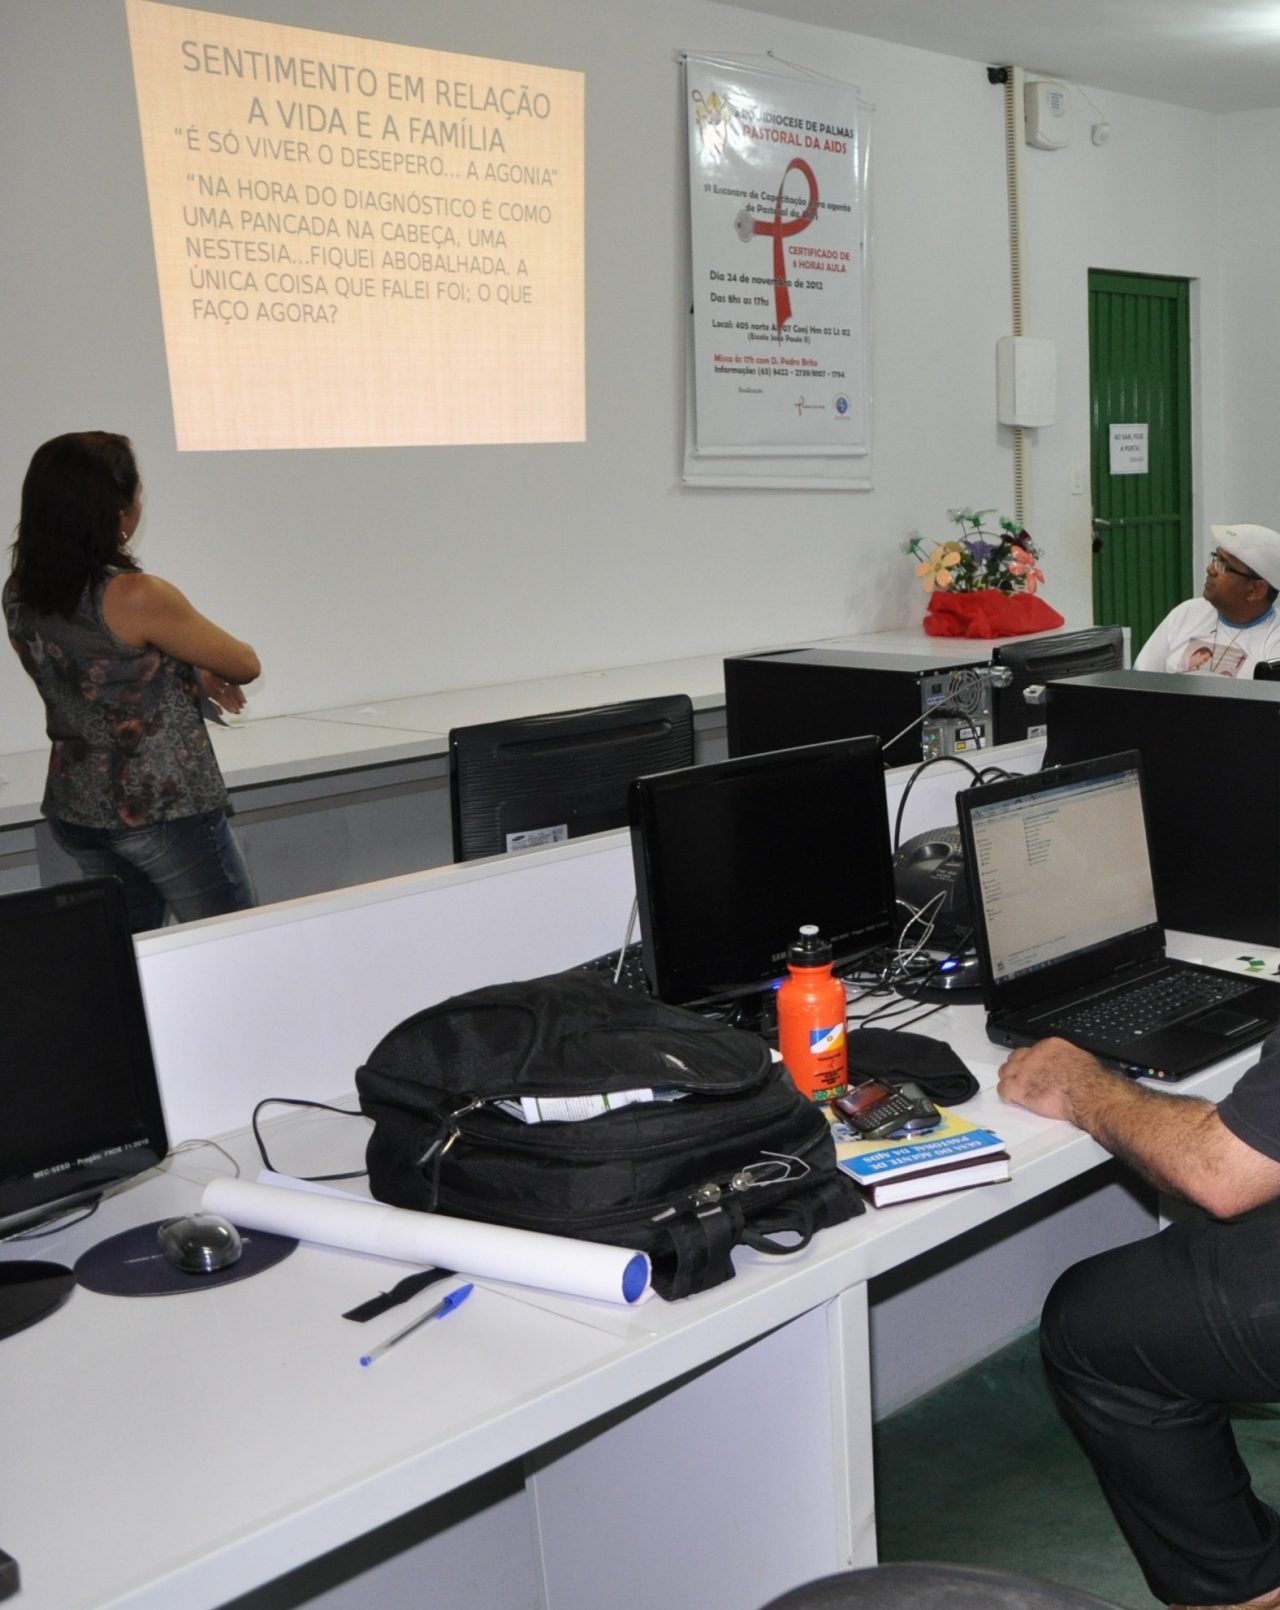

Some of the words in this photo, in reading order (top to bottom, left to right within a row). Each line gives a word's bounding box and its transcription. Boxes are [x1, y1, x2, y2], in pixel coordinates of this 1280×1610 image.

[181, 40, 377, 97] SENTIMENTO
[388, 72, 425, 103] EM
[436, 80, 551, 120] RELAÇÃO
[248, 97, 268, 126] A
[276, 99, 347, 136] VIDA
[357, 111, 372, 138] E
[382, 115, 400, 142] A
[409, 117, 506, 153] FAMÍLIA
[805, 120, 818, 132] DE
[820, 122, 854, 139] PALMAS
[743, 125, 803, 147] PASTORAL
[805, 135, 821, 150] DA
[824, 139, 848, 155] AIDS
[208, 129, 240, 155] SÓ
[246, 135, 311, 163] VIVER
[318, 144, 333, 165] O
[466, 161, 479, 180] A
[237, 178, 300, 204] HORA
[305, 185, 337, 207] DO
[344, 188, 476, 218] DIAGNÓSTICO
[482, 198, 493, 220] É
[498, 202, 552, 224] COMO
[749, 189, 759, 200] de
[183, 205, 234, 230] UMA
[240, 210, 341, 238] PANCADA
[346, 219, 374, 240] NA
[381, 221, 460, 249] CABEÇA,
[468, 228, 507, 248] UMA
[382, 251, 511, 276] ABOBALHADA.
[516, 259, 528, 276] A
[788, 246, 838, 260] CERTIFICADO
[840, 251, 851, 261] DE
[799, 260, 825, 271] HORAS
[827, 262, 847, 273] AULA
[190, 264, 258, 292] ÚNICA
[265, 272, 328, 295] COISA
[335, 276, 376, 298] QUE
[382, 279, 430, 299] FALEI
[478, 283, 491, 302] O
[496, 284, 533, 305] QUE
[710, 270, 725, 282] Dia
[727, 273, 737, 282] 24
[739, 274, 749, 284] de
[794, 278, 804, 288] de
[806, 280, 824, 290] 2012
[192, 299, 249, 325] FAÇO
[256, 302, 338, 324] AGORA?
[869, 1161, 888, 1171] DE
[891, 1152, 932, 1166] AGENTE
